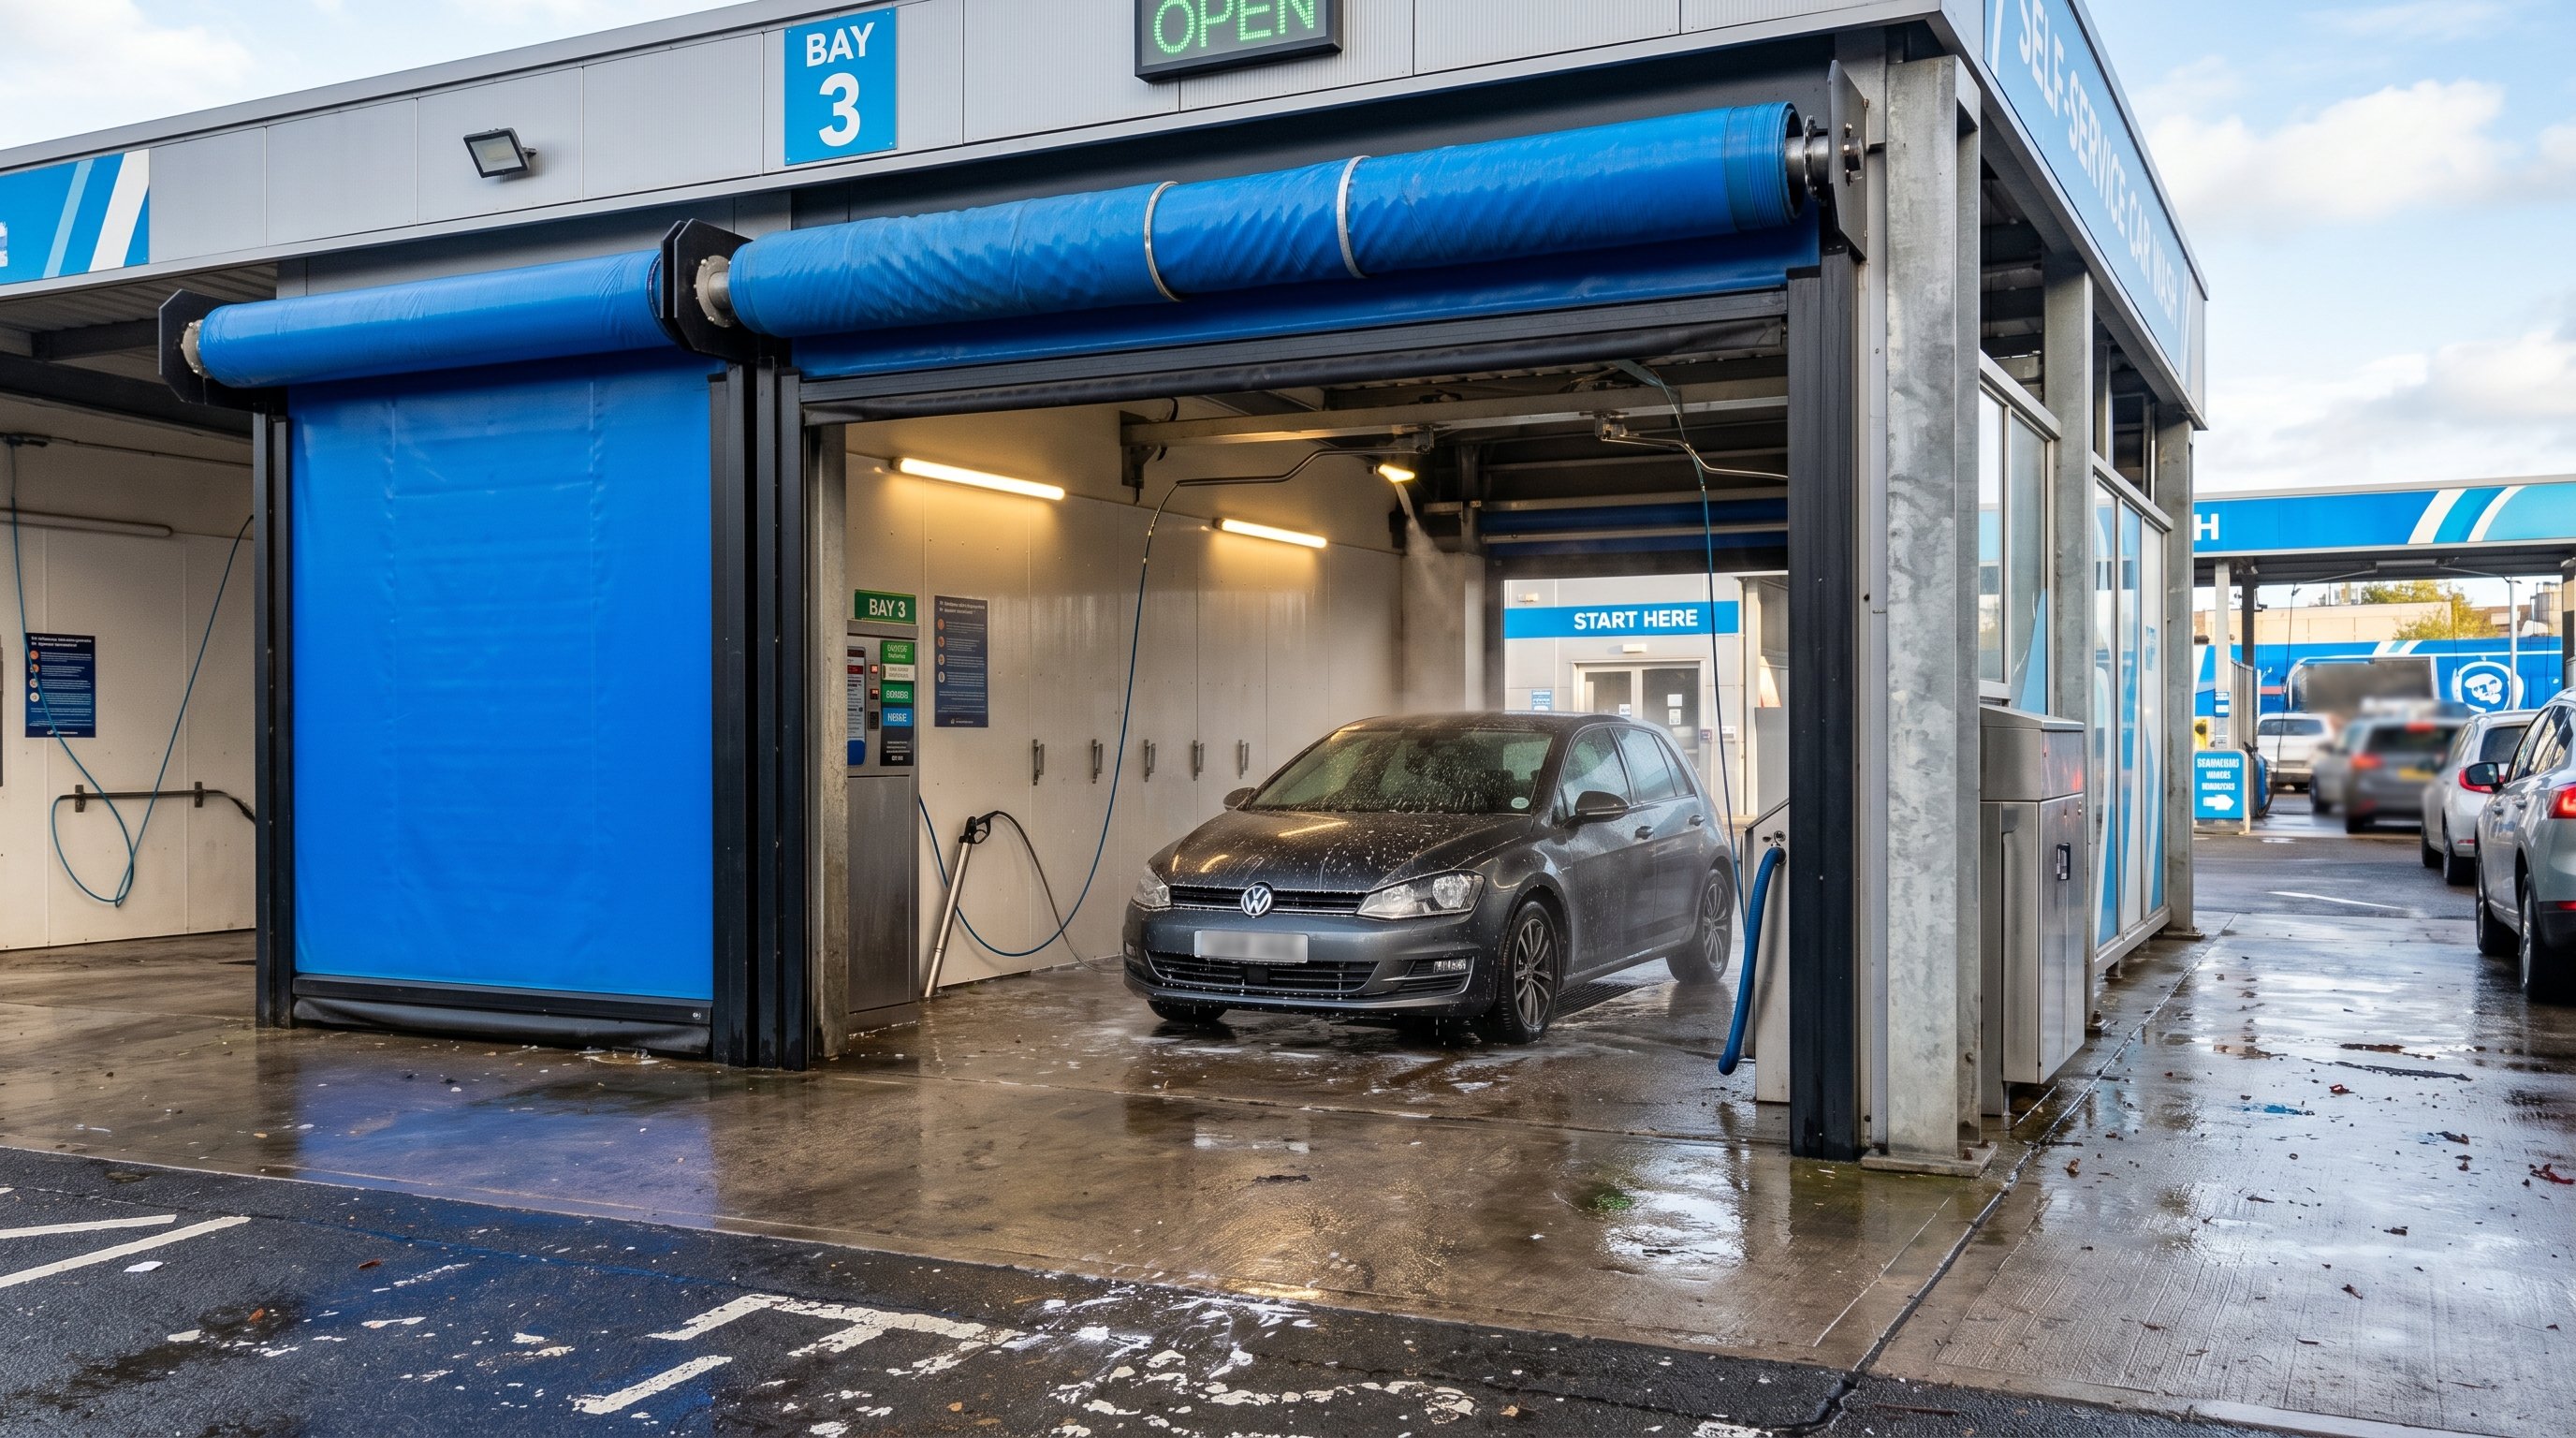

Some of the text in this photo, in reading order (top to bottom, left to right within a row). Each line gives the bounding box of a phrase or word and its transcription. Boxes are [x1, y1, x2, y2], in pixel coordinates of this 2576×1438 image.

[805, 22, 875, 67] BAY
[1153, 0, 1314, 53] OPEN
[818, 72, 860, 147] 3
[2019, 0, 2177, 330] SELF-SERVICE CAR WASH
[869, 598, 906, 618] BAY 3
[1573, 609, 1698, 630] START HERE
